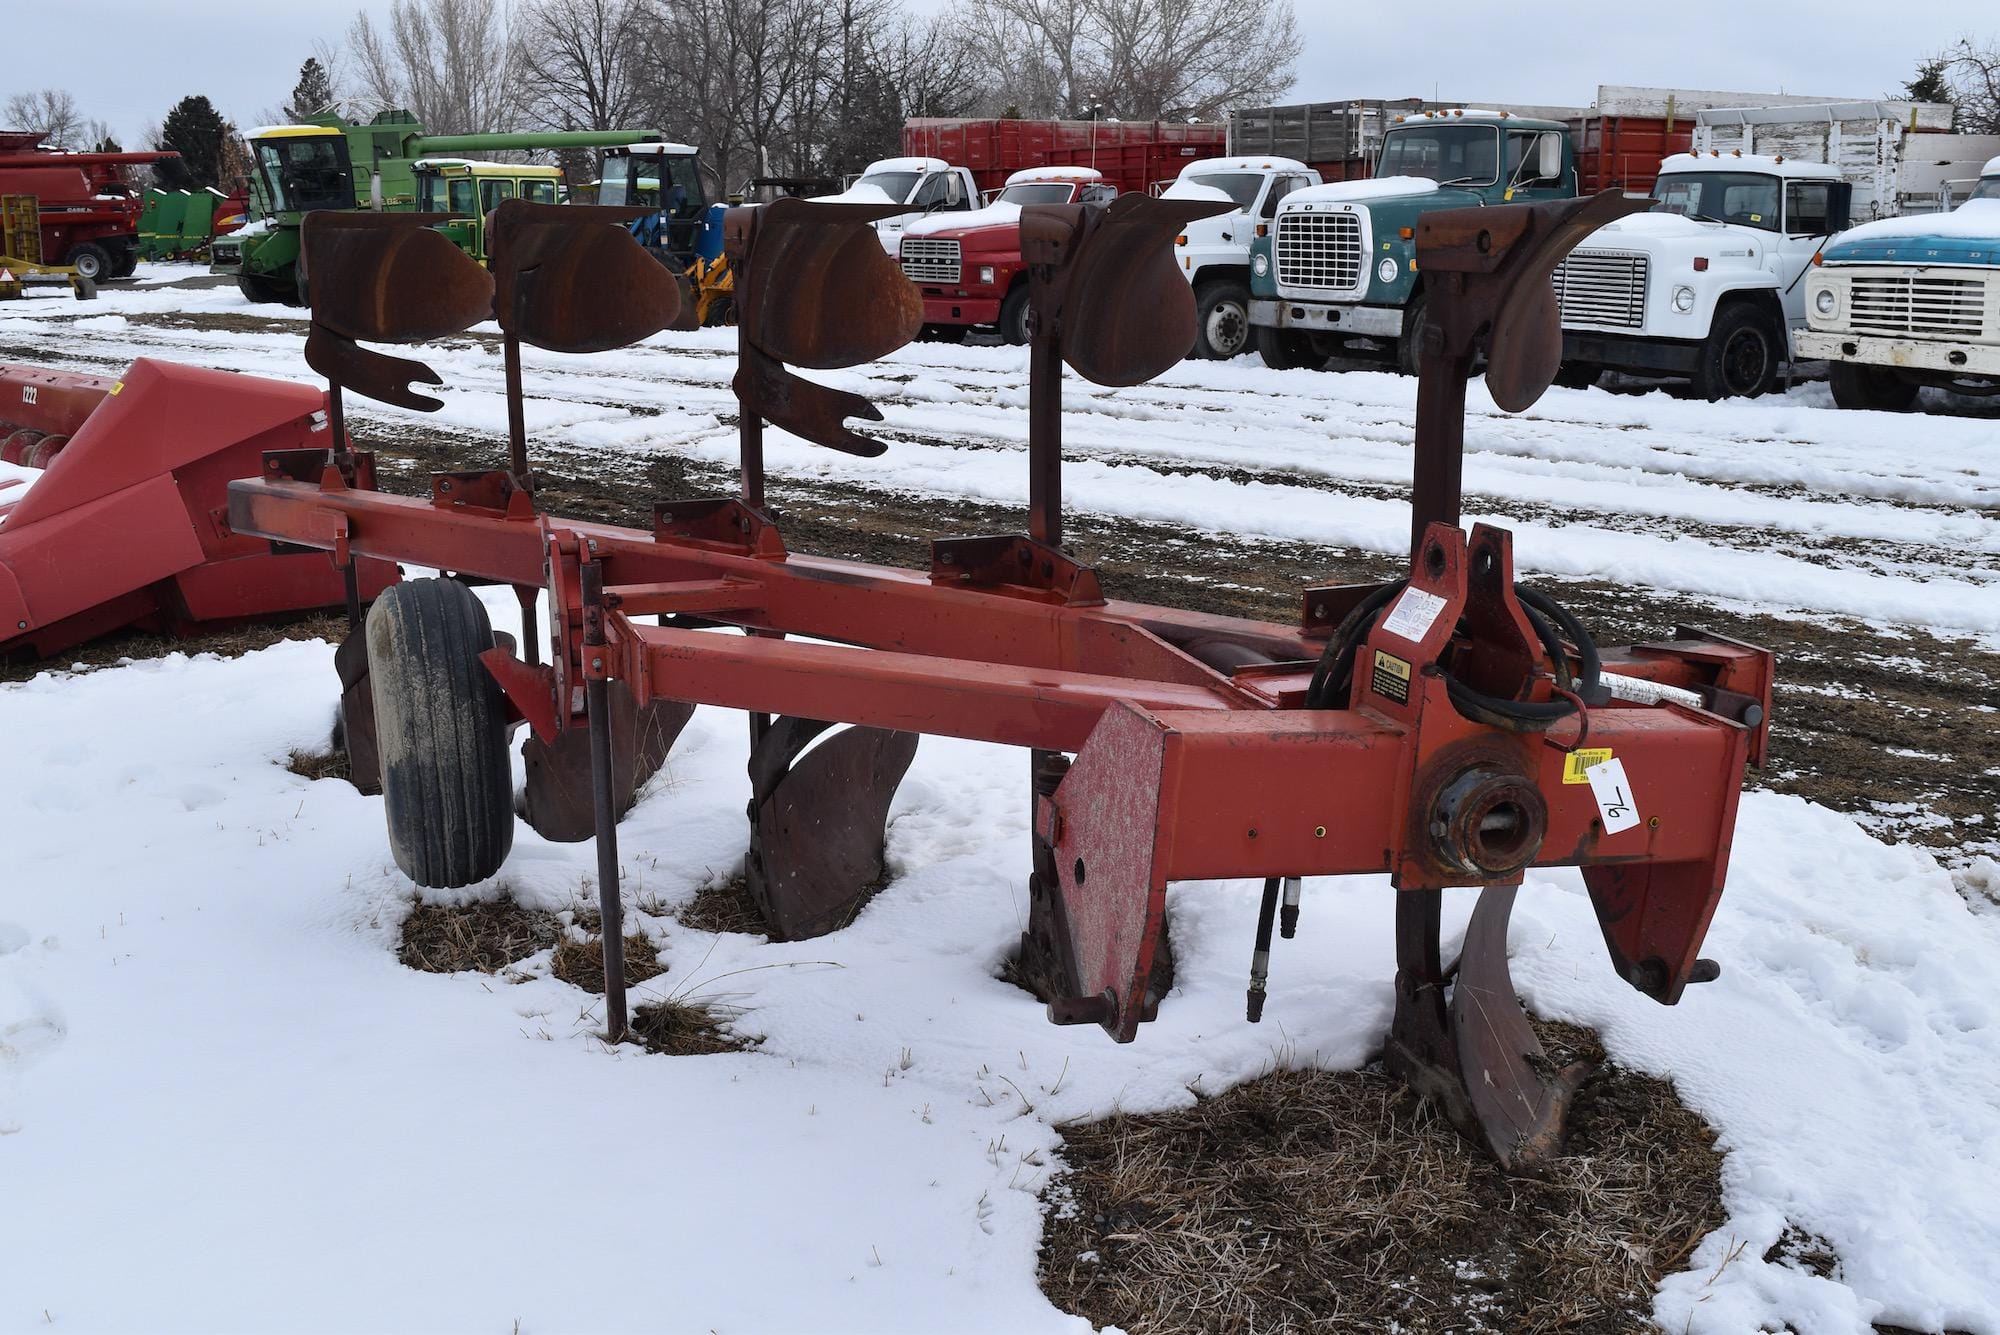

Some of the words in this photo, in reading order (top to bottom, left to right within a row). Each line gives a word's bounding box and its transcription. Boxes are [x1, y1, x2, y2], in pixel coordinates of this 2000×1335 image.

[1286, 204, 1352, 212] FORD
[1573, 249, 1631, 257] NTERNATIONAL
[1851, 248, 1981, 259] FORD
[22, 385, 38, 405] 1222
[1602, 786, 1630, 818] 76
